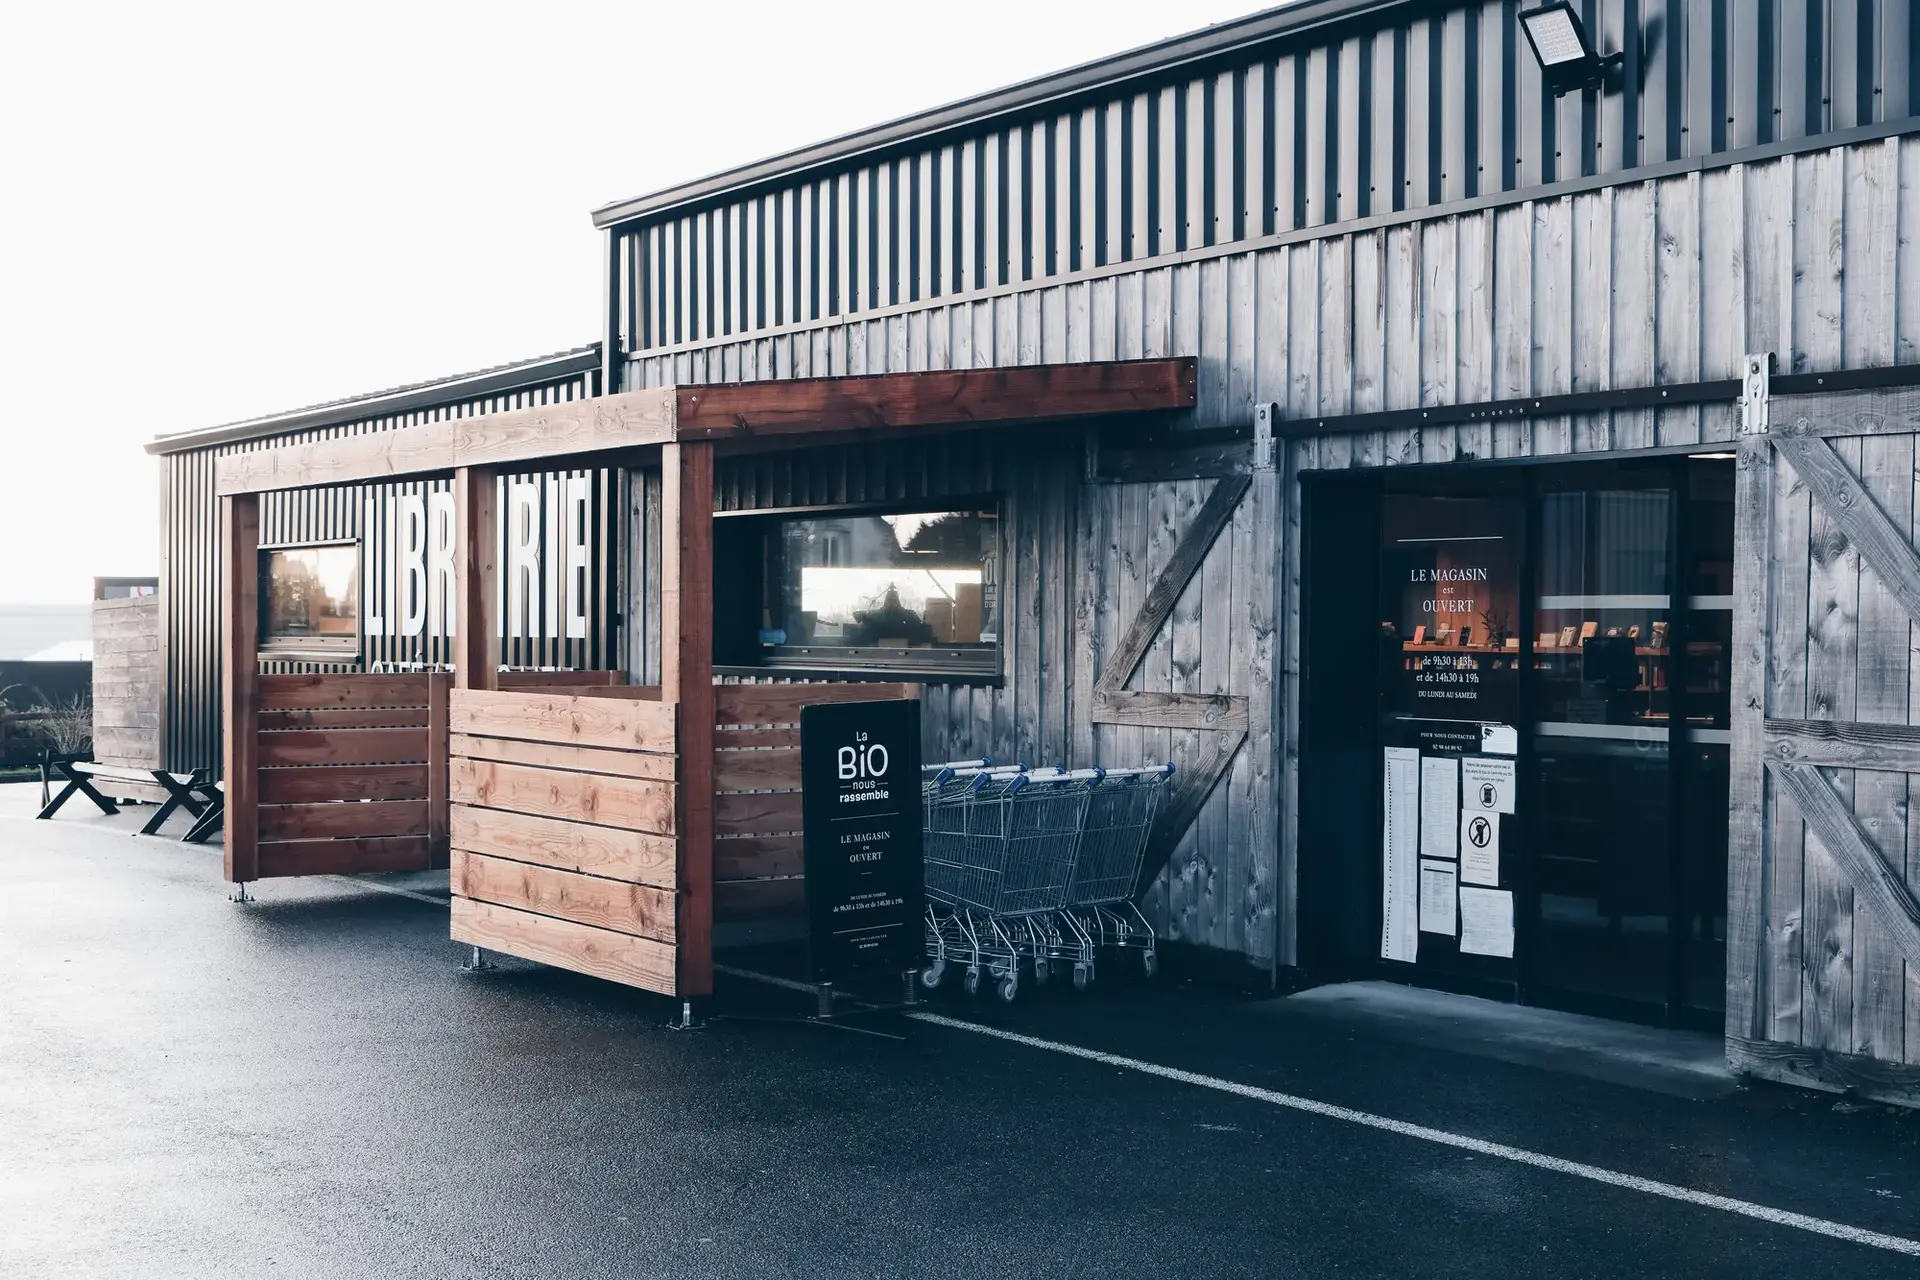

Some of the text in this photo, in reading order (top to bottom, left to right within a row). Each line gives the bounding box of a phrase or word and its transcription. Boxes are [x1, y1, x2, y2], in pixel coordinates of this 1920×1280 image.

[365, 478, 588, 639] LIBRIRIE
[1411, 568, 1488, 582] LE MAGASIN
[1423, 600, 1474, 613] OUVERT
[1422, 656, 1473, 666] de 9h30 à 13h
[1416, 672, 1480, 683] et de 14h30 à 19h
[856, 731, 868, 742] La
[853, 780, 876, 790] nous
[840, 789, 889, 803] rassemble
[841, 831, 891, 844] LE MAGASIN
[849, 851, 883, 863] OUVERT
